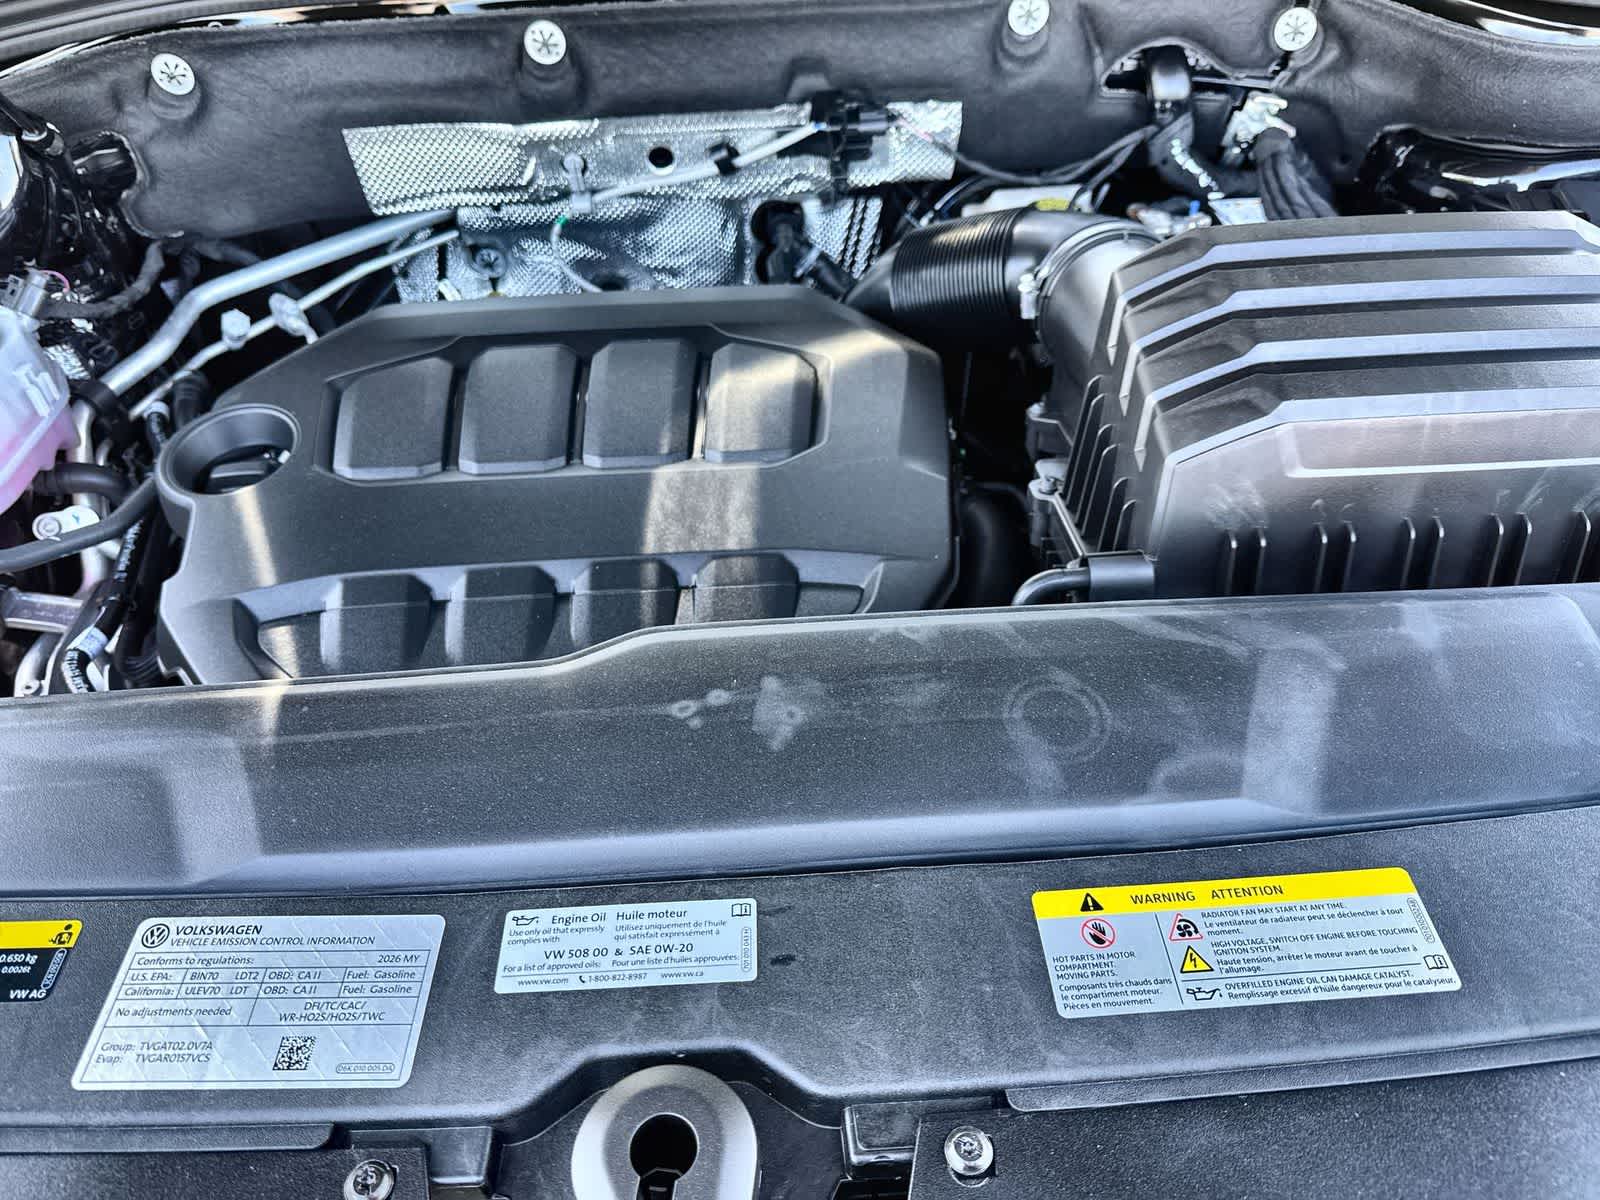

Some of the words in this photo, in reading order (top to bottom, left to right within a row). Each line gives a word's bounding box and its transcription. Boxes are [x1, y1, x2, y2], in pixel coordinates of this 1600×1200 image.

[1130, 891, 1196, 905] WARNING
[1211, 885, 1284, 900] ATTENTION
[1275, 905, 1298, 913] START
[1310, 903, 1325, 911] ANY
[552, 914, 588, 926] Engine
[591, 912, 606, 922] Oil
[616, 910, 645, 920] Huile
[647, 909, 687, 919] moteur
[1215, 919, 1258, 928] ventilateur
[1270, 915, 1306, 923] radiateur
[1307, 913, 1326, 922] peut
[1337, 910, 1379, 918] déclencher
[176, 925, 262, 936] VOLKSWAGEN
[524, 928, 540, 937] only
[570, 925, 605, 934] expressly
[645, 922, 691, 931] uniquement
[170, 938, 208, 946] VEHICLE
[210, 937, 258, 946] EMISSION
[260, 936, 304, 946] CONTROL
[306, 936, 376, 945] INFORMATION
[507, 936, 541, 946] complies
[543, 935, 560, 943] with
[614, 933, 627, 941] qui
[628, 931, 658, 939] satisfait
[1211, 940, 1231, 949] HIGH
[1269, 936, 1299, 944] SWITCH
[1300, 934, 1314, 942] OFF
[1316, 932, 1345, 941] ENGINE
[1346, 929, 1377, 939] BEFORE
[1378, 927, 1418, 936] TOUCHING
[544, 950, 565, 960] VW
[568, 948, 590, 959] 508
[592, 947, 609, 957] 00
[614, 948, 624, 956] &
[629, 945, 652, 955] SAE
[654, 943, 694, 953] 0W-20
[1107, 951, 1136, 959] MOTOR
[1214, 947, 1249, 956] IGNITION
[1217, 958, 1241, 966] Haute
[1243, 956, 1276, 965] tension,
[1276, 953, 1304, 961] arrêter
[1314, 950, 1343, 959] moteur
[1345, 949, 1367, 957] avant
[1368, 947, 1379, 955] de
[1380, 945, 1411, 954] toucher
[25, 953, 38, 964] kg
[137, 956, 182, 966] Conforms
[185, 956, 195, 964] to
[196, 955, 254, 967] regulations:
[378, 954, 402, 964] 2026
[403, 954, 420, 963] MY
[647, 957, 662, 965] liste
[547, 962, 583, 972] approved
[130, 973, 147, 982] U.S.
[190, 972, 220, 980] BIN70
[235, 971, 259, 980] LDT2
[268, 971, 294, 980] OBD:
[346, 970, 370, 979] Fuel:
[374, 970, 416, 979] Gasoline
[1057, 972, 1089, 980] MOVING
[1090, 970, 1118, 978] PARTS.
[518, 978, 569, 986] www.vw.com
[1059, 981, 1107, 992] Composants
[1108, 980, 1123, 989] très
[1125, 978, 1153, 987] chauds
[1153, 977, 1173, 985] dans
[1225, 980, 1274, 991] OVERFILLED
[1275, 977, 1305, 987] ENGINE
[1306, 976, 1320, 985] OIL
[1321, 975, 1337, 984] CAN
[1339, 973, 1371, 982] DAMAGE
[1373, 970, 1414, 980] CATALYST.
[124, 987, 174, 996] California:
[184, 986, 221, 996] ULEV70
[230, 986, 248, 995] LDT
[263, 986, 289, 995] OBD:
[342, 985, 365, 994] Fuel:
[370, 984, 412, 994] Gasoline
[1228, 990, 1279, 1001] Remplissage
[1280, 986, 1311, 996] excessif
[1313, 984, 1340, 994] d'huile
[1341, 982, 1383, 993] dangereux
[1384, 981, 1403, 990] pour
[1413, 977, 1456, 988] catalyseur.
[10, 989, 28, 1000] VW
[28, 989, 46, 999] AG
[1070, 990, 1129, 1001] compartiment
[304, 1001, 368, 1011] DFI/TC/CAC/
[1064, 1002, 1090, 1011] Pièces
[116, 1008, 129, 1017] No
[131, 1006, 193, 1019] adjustments
[194, 1006, 232, 1016] needed
[100, 1042, 136, 1053] Group:
[96, 1054, 124, 1066] Evap:
